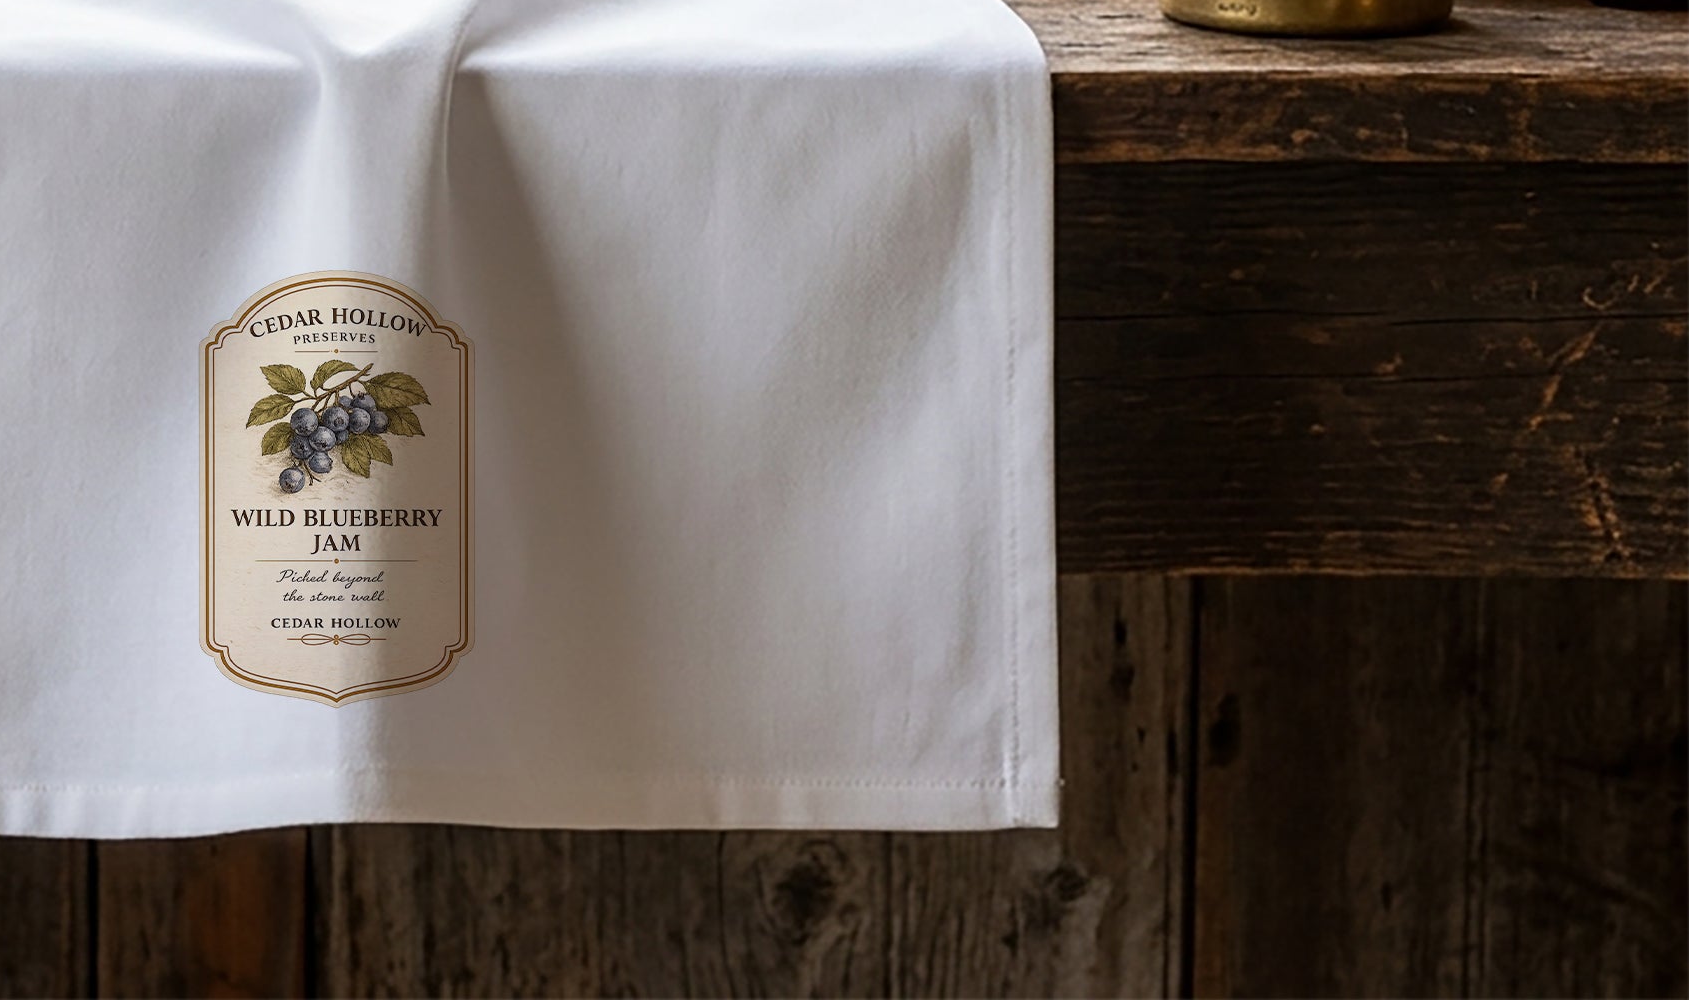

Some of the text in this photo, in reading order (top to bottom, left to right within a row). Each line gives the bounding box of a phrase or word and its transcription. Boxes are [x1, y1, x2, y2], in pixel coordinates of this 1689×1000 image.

[249, 307, 427, 338] CEDAR HOLLOW
[293, 332, 376, 344] PRESERVES
[231, 509, 443, 527] WILD BLUEBERRY
[311, 534, 361, 555] JAM
[276, 569, 384, 588] Picked beyond
[283, 590, 305, 602] the
[309, 592, 345, 602] stone
[270, 618, 401, 629] CEDAR HOLLOW
